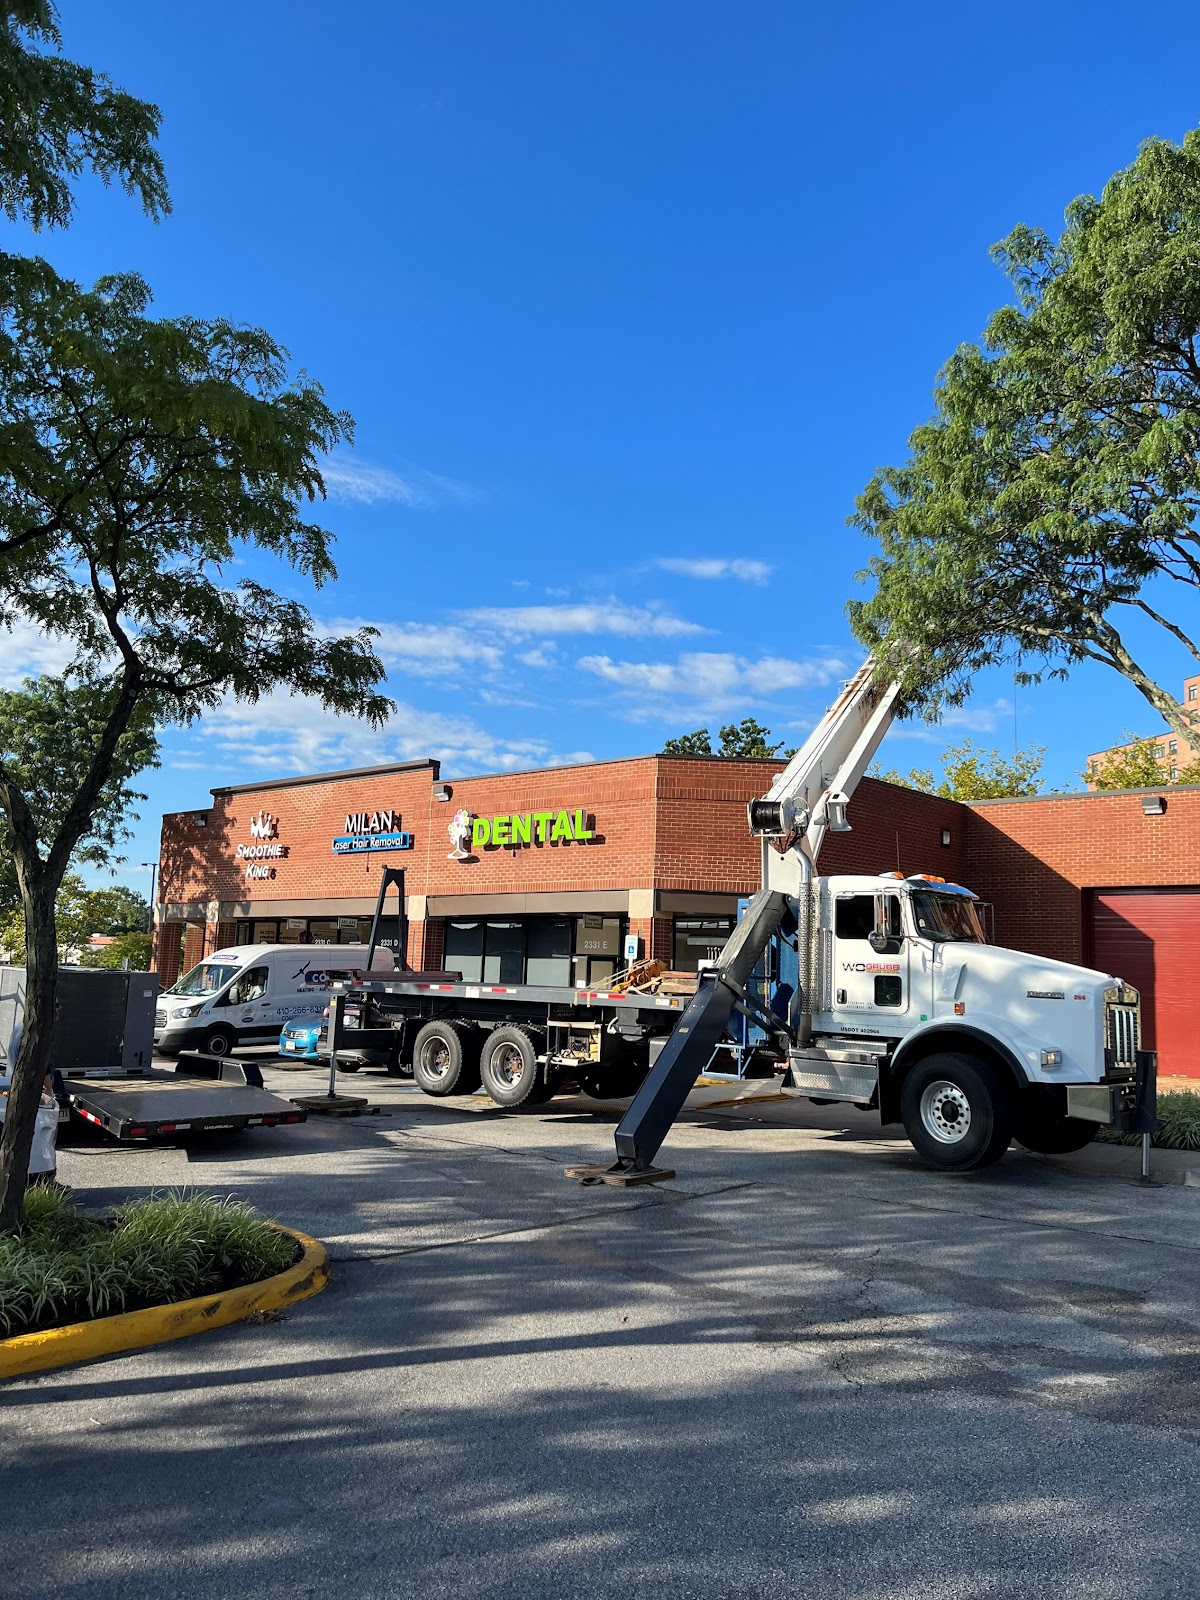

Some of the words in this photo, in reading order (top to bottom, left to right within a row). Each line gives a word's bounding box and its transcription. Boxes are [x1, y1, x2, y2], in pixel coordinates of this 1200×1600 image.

[344, 810, 393, 833] MILAN
[472, 809, 593, 847] DENTAL
[331, 840, 350, 850] Laser
[352, 837, 368, 849] Hair
[370, 834, 403, 847] Removal
[584, 940, 600, 949] 2331
[602, 940, 608, 949] E
